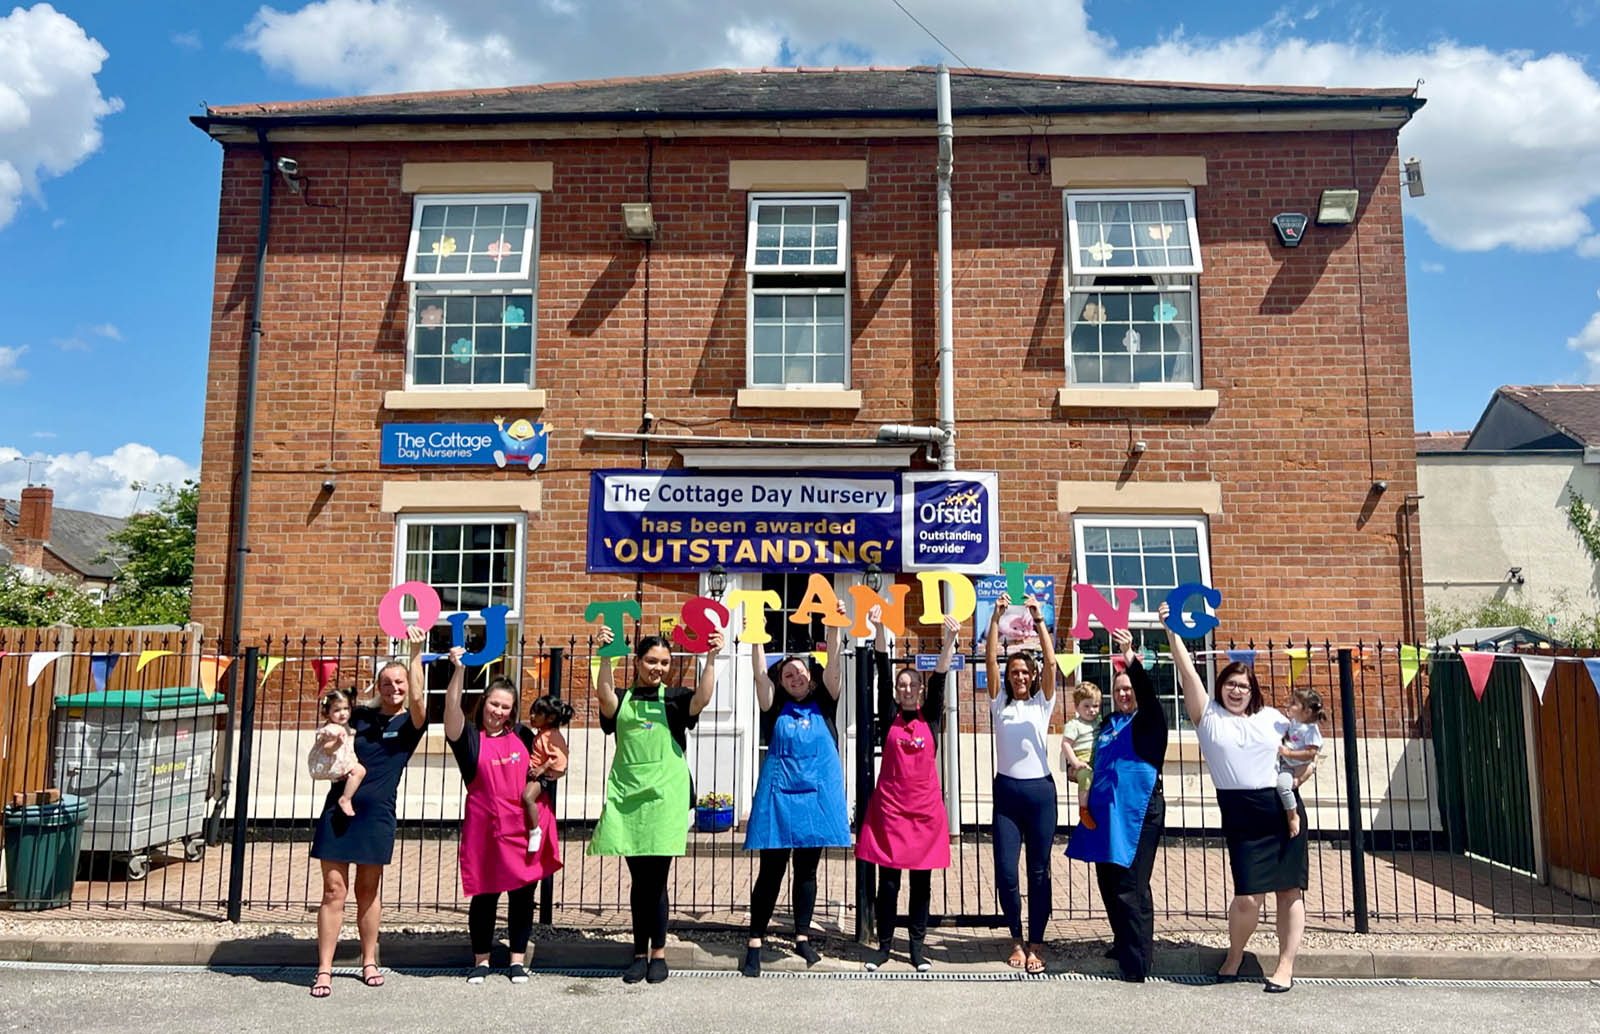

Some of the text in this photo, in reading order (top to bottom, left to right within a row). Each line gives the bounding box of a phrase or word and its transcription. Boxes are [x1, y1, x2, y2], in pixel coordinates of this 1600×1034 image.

[394, 432, 492, 451] The Cottage
[398, 448, 472, 460] Day Nurseries
[611, 483, 887, 508] The Cottage Day Nursery
[920, 502, 982, 525] Ofsted
[641, 517, 856, 535] has been awarded
[919, 530, 982, 543] Outstanding
[603, 537, 894, 564] ‘OUTSTANDING’
[919, 543, 966, 554] Provider
